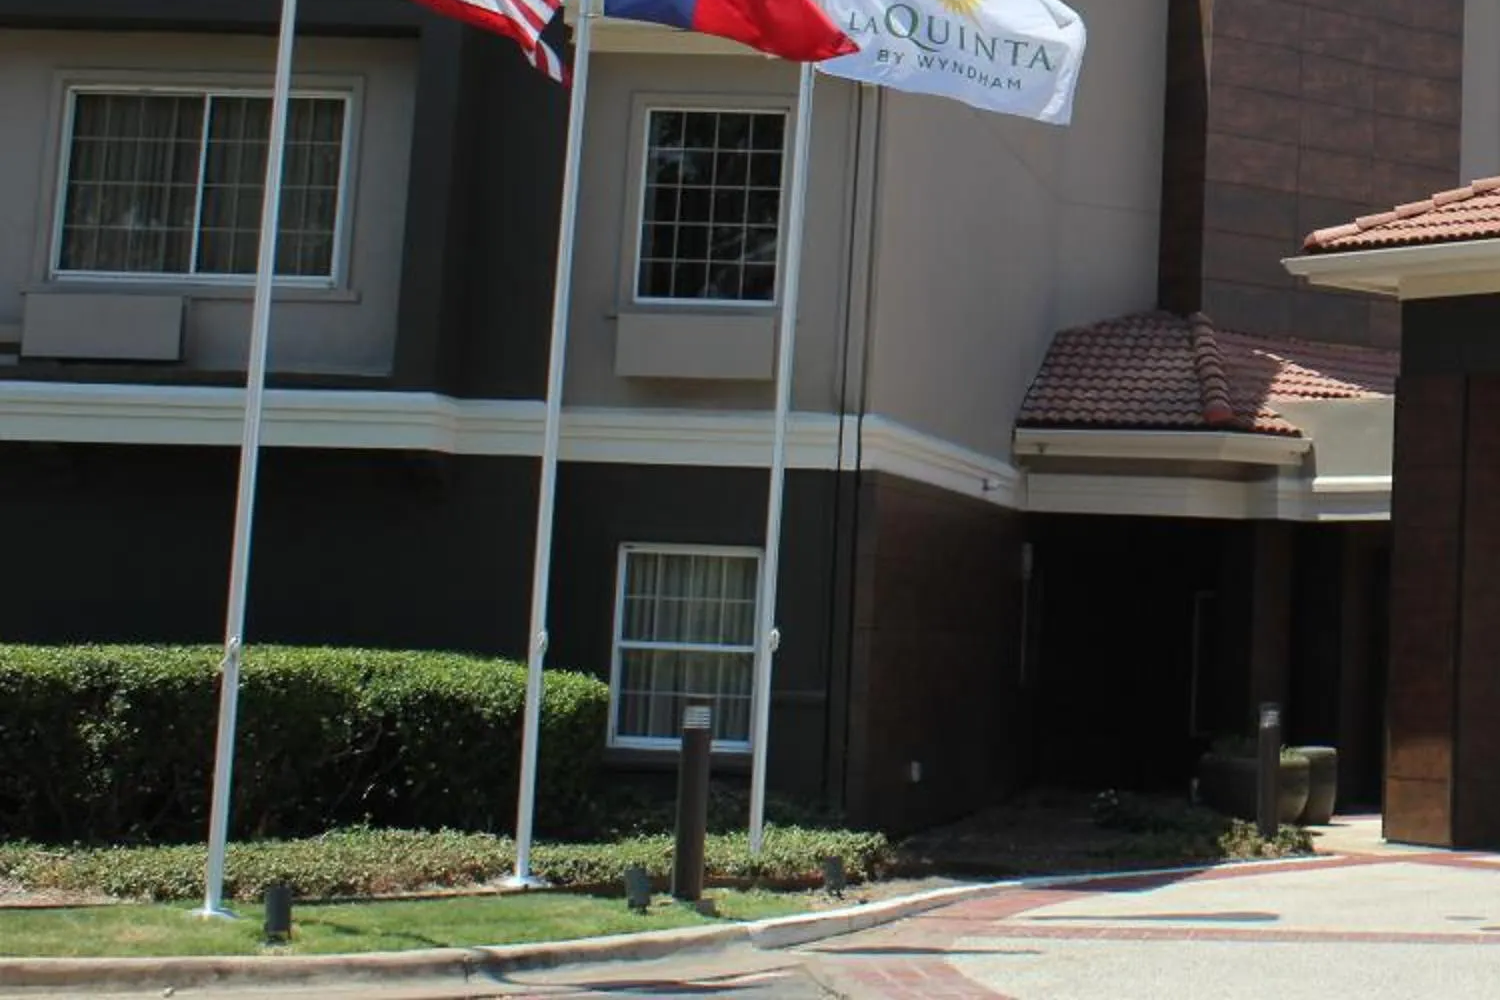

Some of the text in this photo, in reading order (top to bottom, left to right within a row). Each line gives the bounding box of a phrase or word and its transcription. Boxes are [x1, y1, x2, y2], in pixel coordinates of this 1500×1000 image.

[850, 3, 1053, 71] LA QUINTA
[877, 49, 1022, 90] BY WYNDHAM
